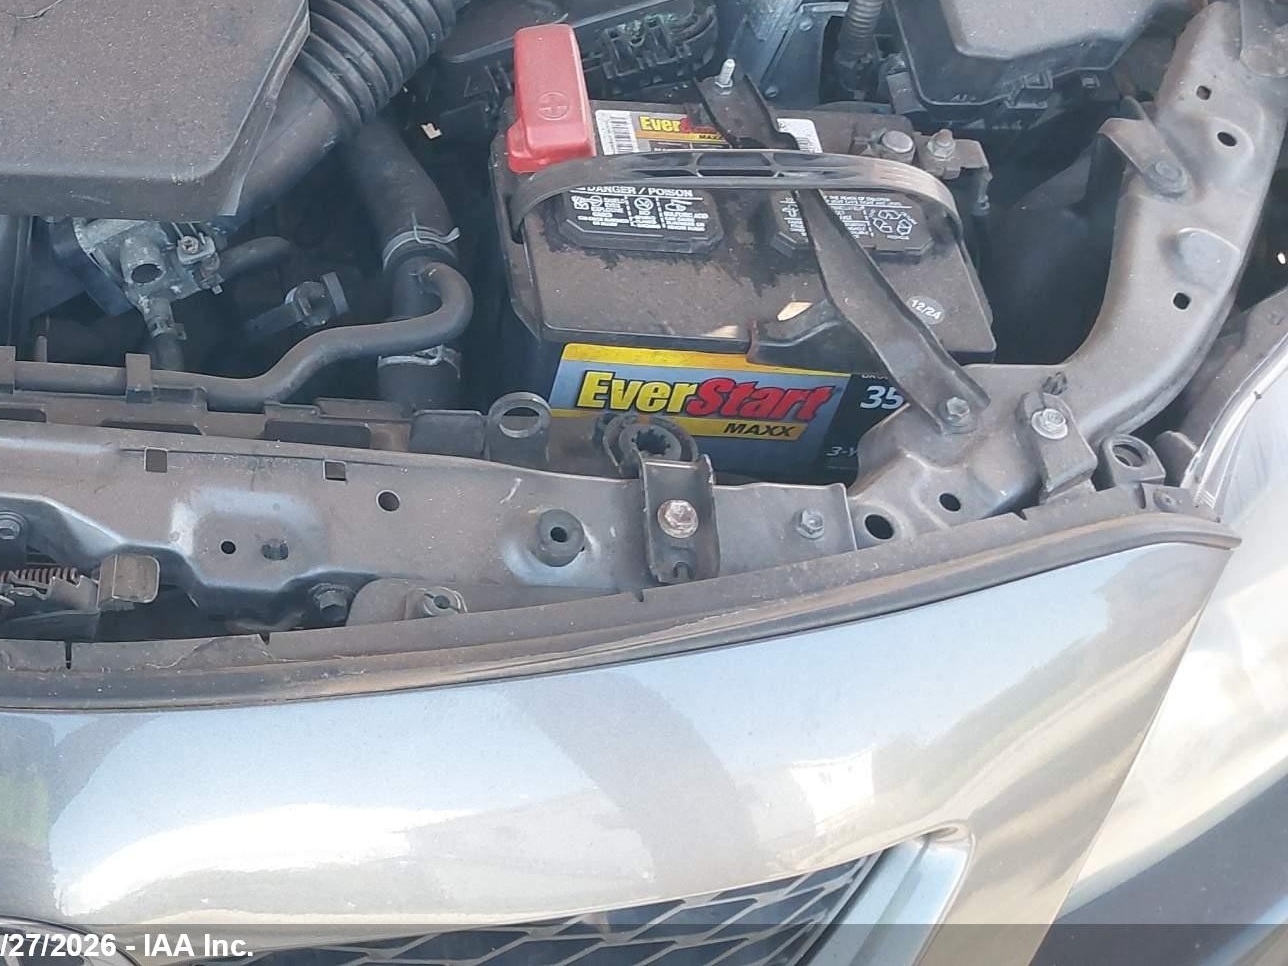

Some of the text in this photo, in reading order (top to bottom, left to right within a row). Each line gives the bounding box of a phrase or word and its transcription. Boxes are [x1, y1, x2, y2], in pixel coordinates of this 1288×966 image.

[647, 187, 694, 197] POISON
[911, 299, 942, 320] 12/24
[575, 369, 836, 422] EverStart
[723, 422, 797, 437] MAXX
